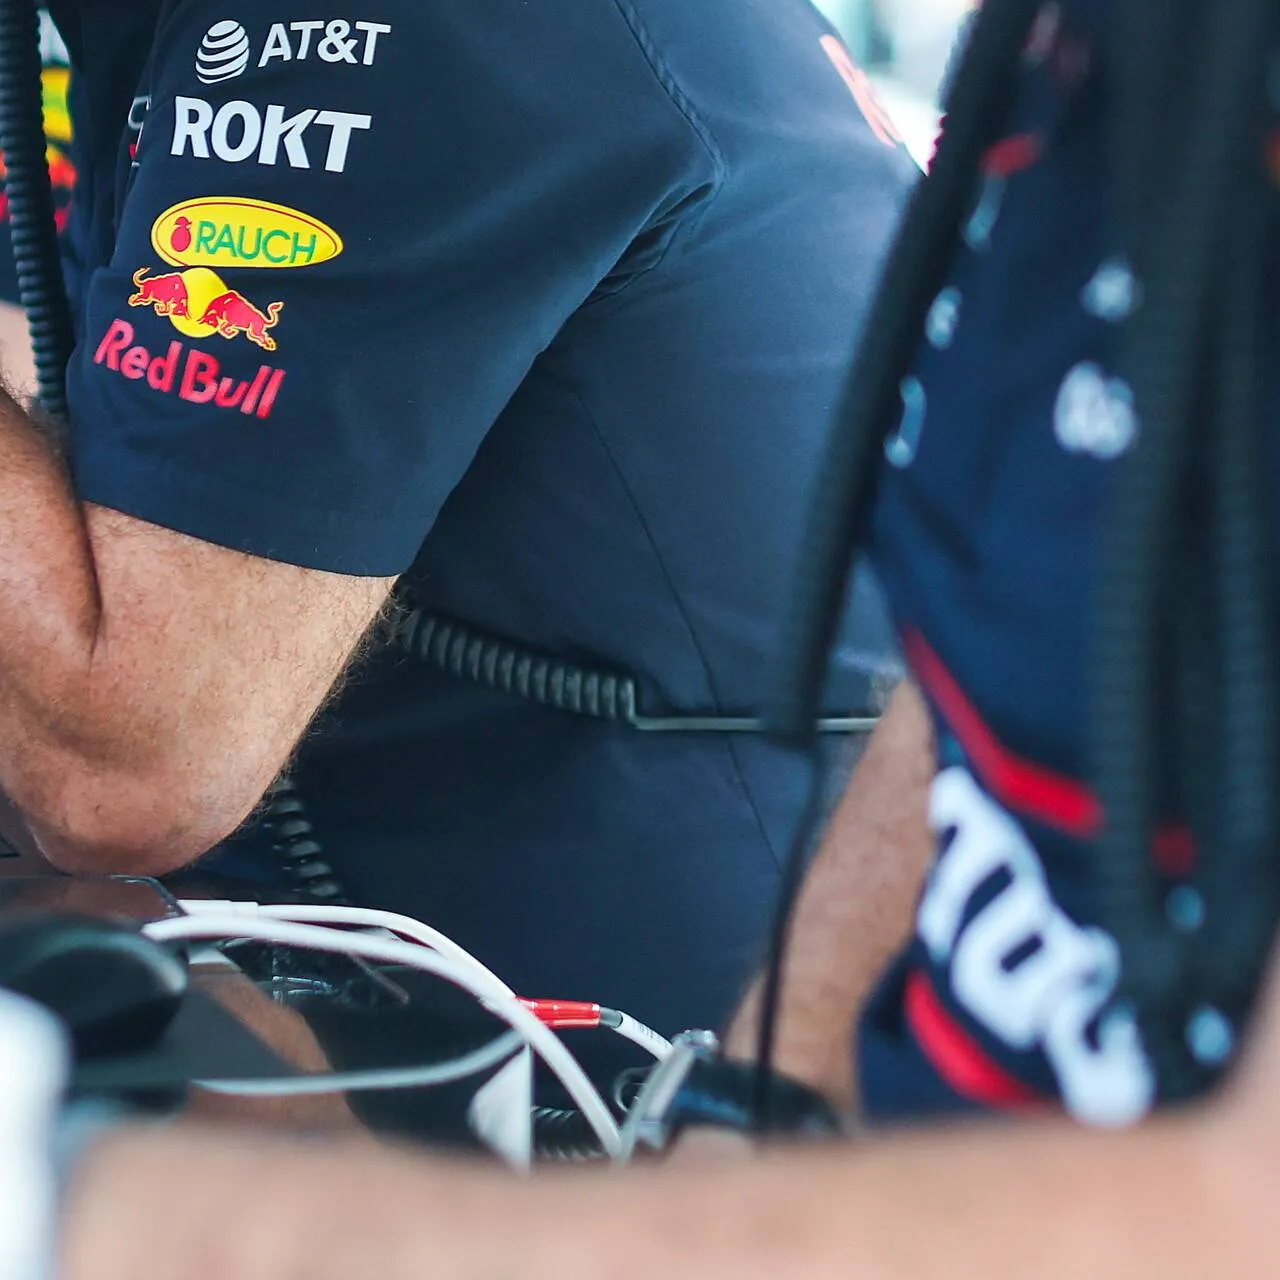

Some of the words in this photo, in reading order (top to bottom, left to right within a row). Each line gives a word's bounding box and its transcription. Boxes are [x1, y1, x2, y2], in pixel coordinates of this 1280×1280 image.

[258, 19, 391, 68] AT&T
[170, 95, 372, 173] ROKT
[195, 220, 318, 264] RAUCH
[93, 318, 184, 392] Red
[178, 349, 287, 419] Bull
